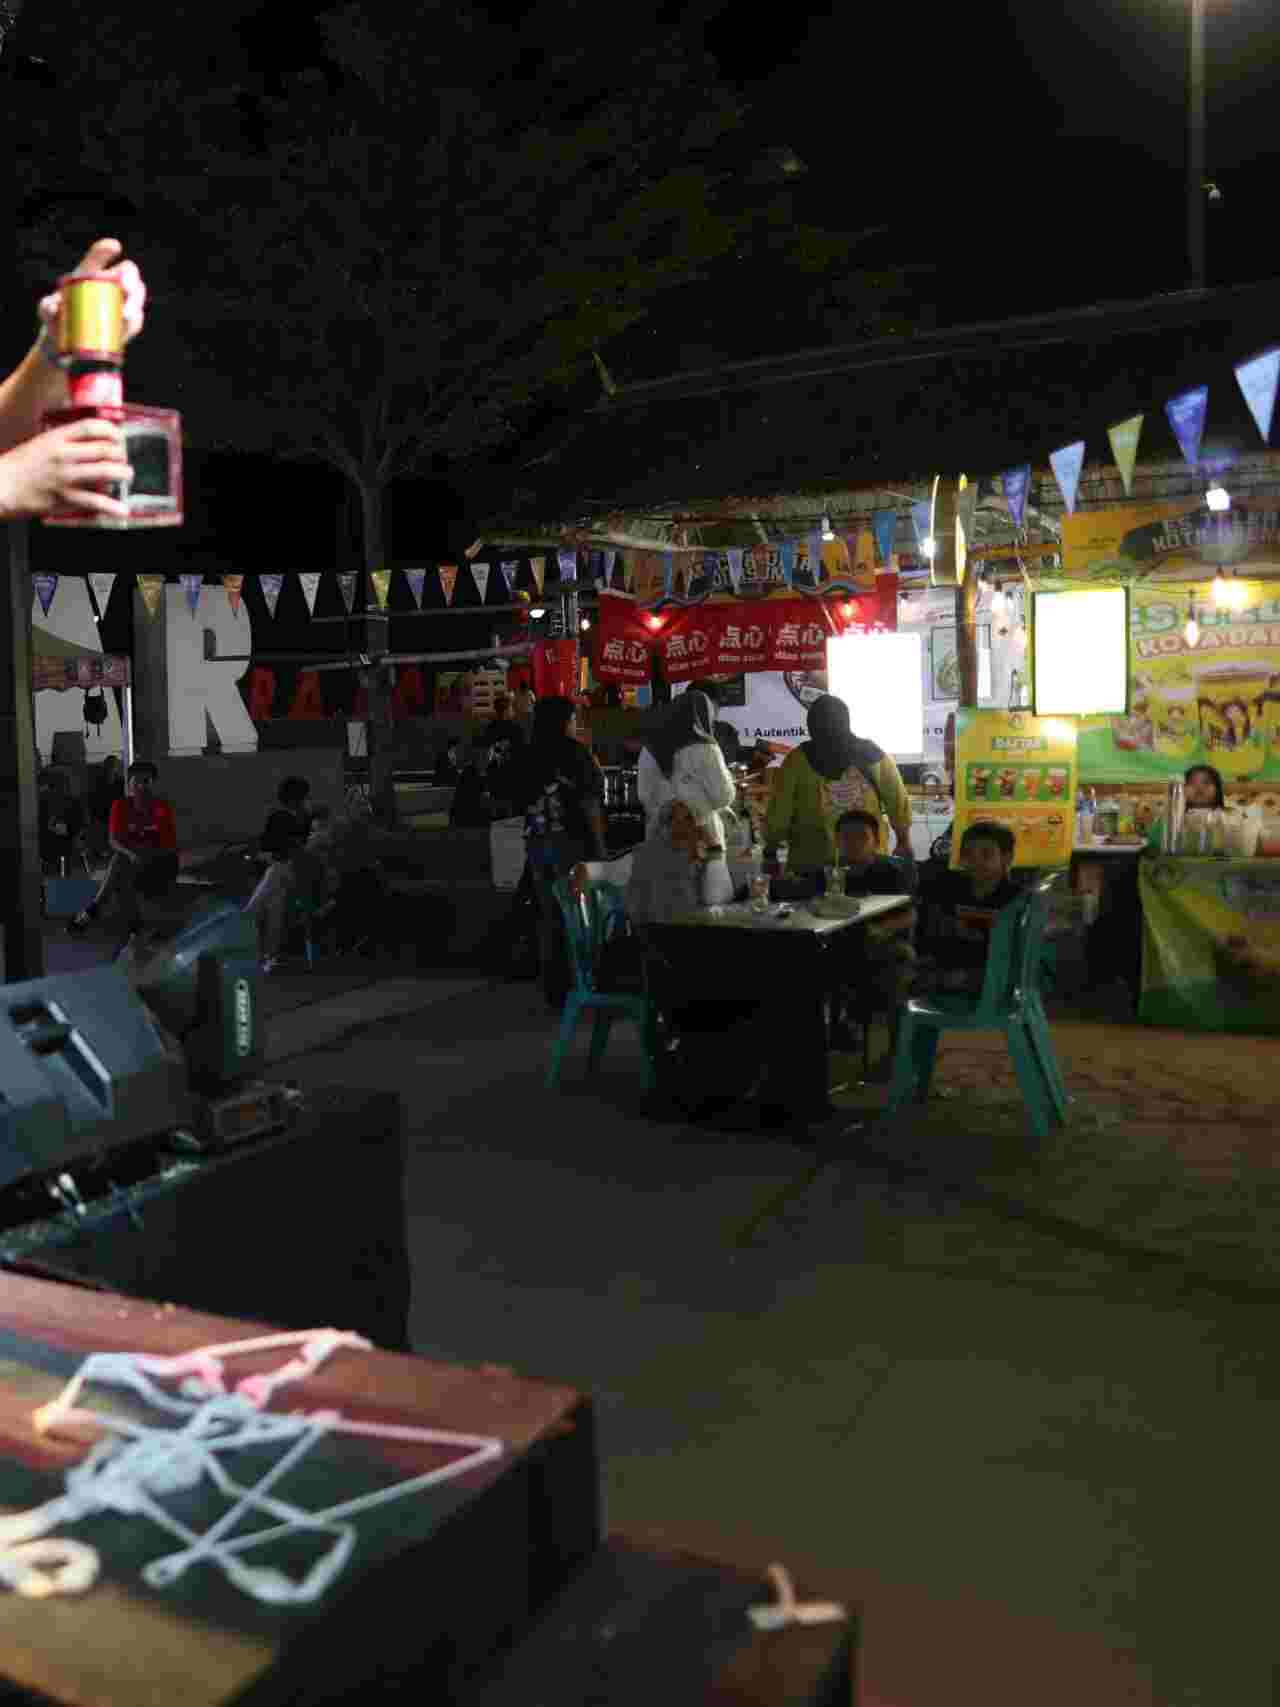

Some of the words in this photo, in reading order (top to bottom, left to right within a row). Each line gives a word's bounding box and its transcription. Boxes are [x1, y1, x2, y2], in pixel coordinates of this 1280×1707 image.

[666, 630, 709, 658] 点心
[719, 625, 765, 649] 点心
[776, 621, 824, 646] 点心
[602, 637, 647, 663] 点心
[754, 726, 806, 737] Autentik
